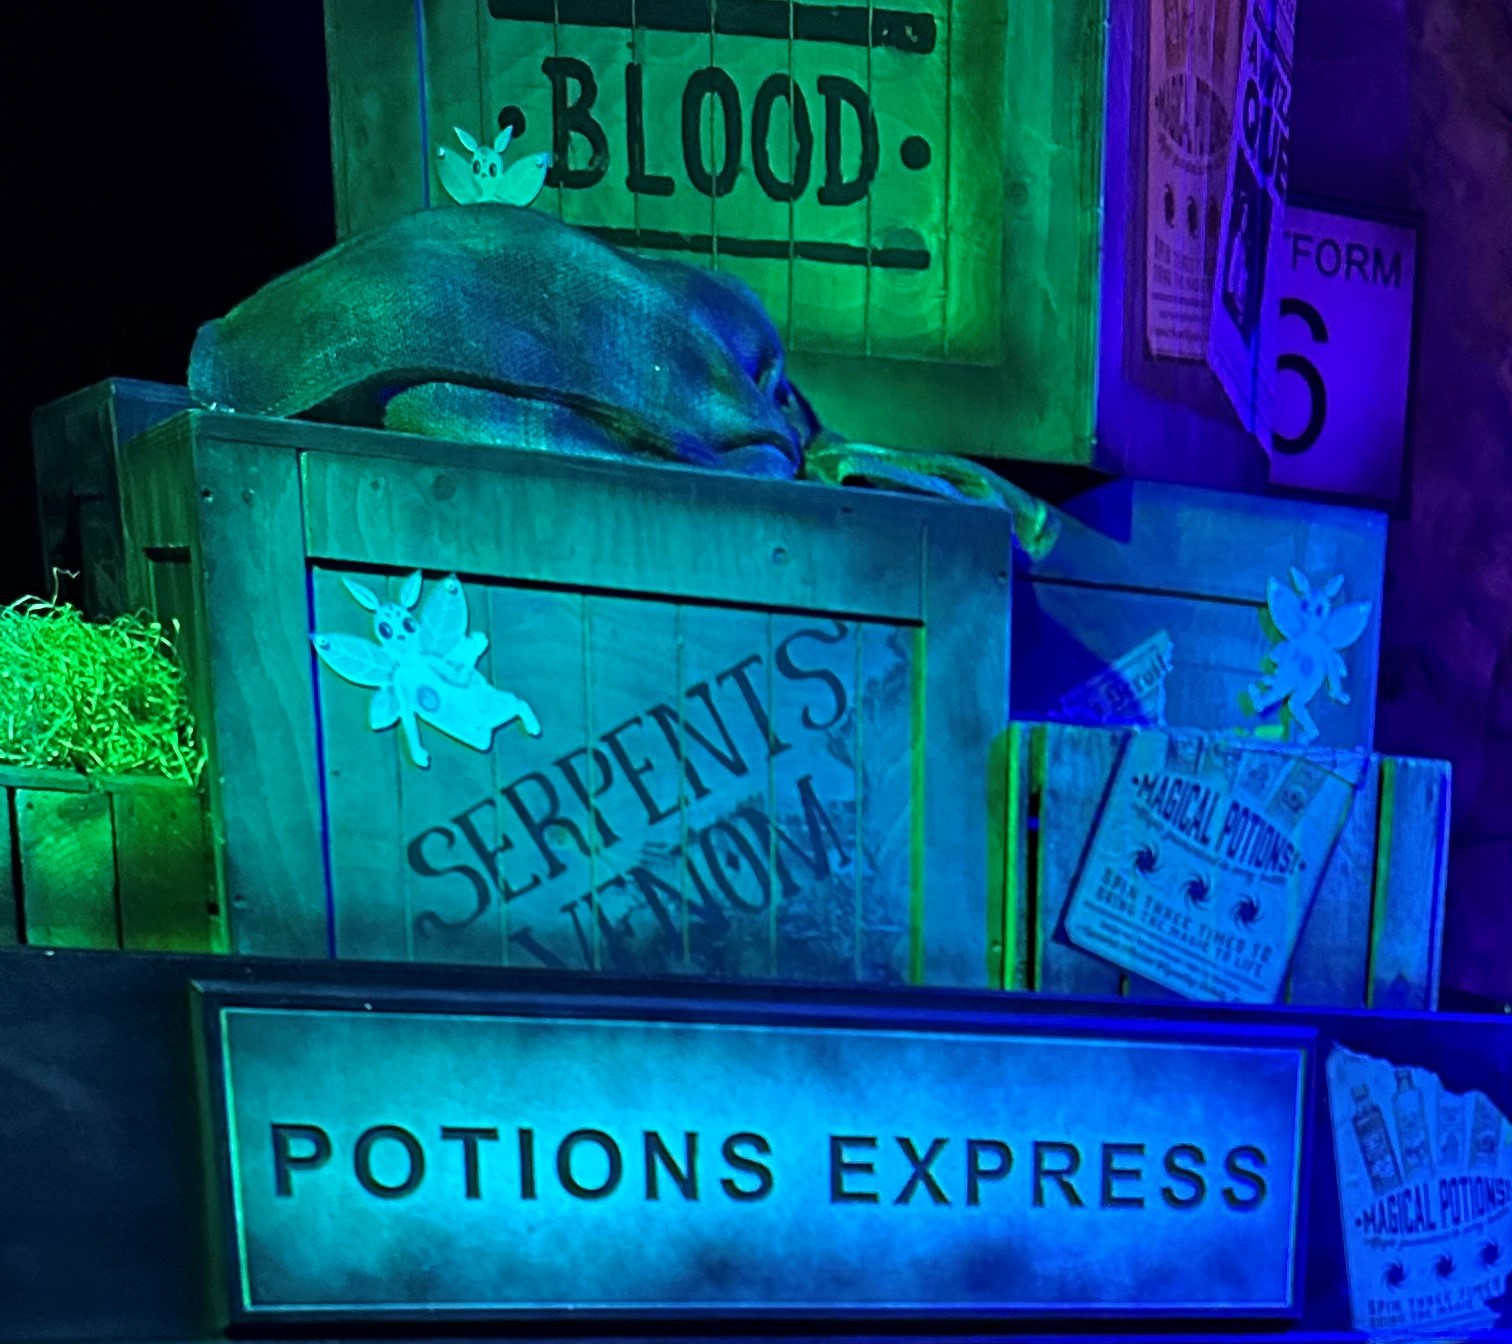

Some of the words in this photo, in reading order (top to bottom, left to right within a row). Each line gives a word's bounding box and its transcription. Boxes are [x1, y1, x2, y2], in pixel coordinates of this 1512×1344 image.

[542, 57, 878, 205] BLOOD
[1284, 231, 1402, 288] FORM
[407, 619, 849, 932] SERPENTS
[1138, 773, 1220, 848] MAGICAL
[270, 1121, 776, 1201] POTIONS
[828, 1134, 1269, 1213] EXPRESS
[1362, 1180, 1437, 1235] MAGICAL
